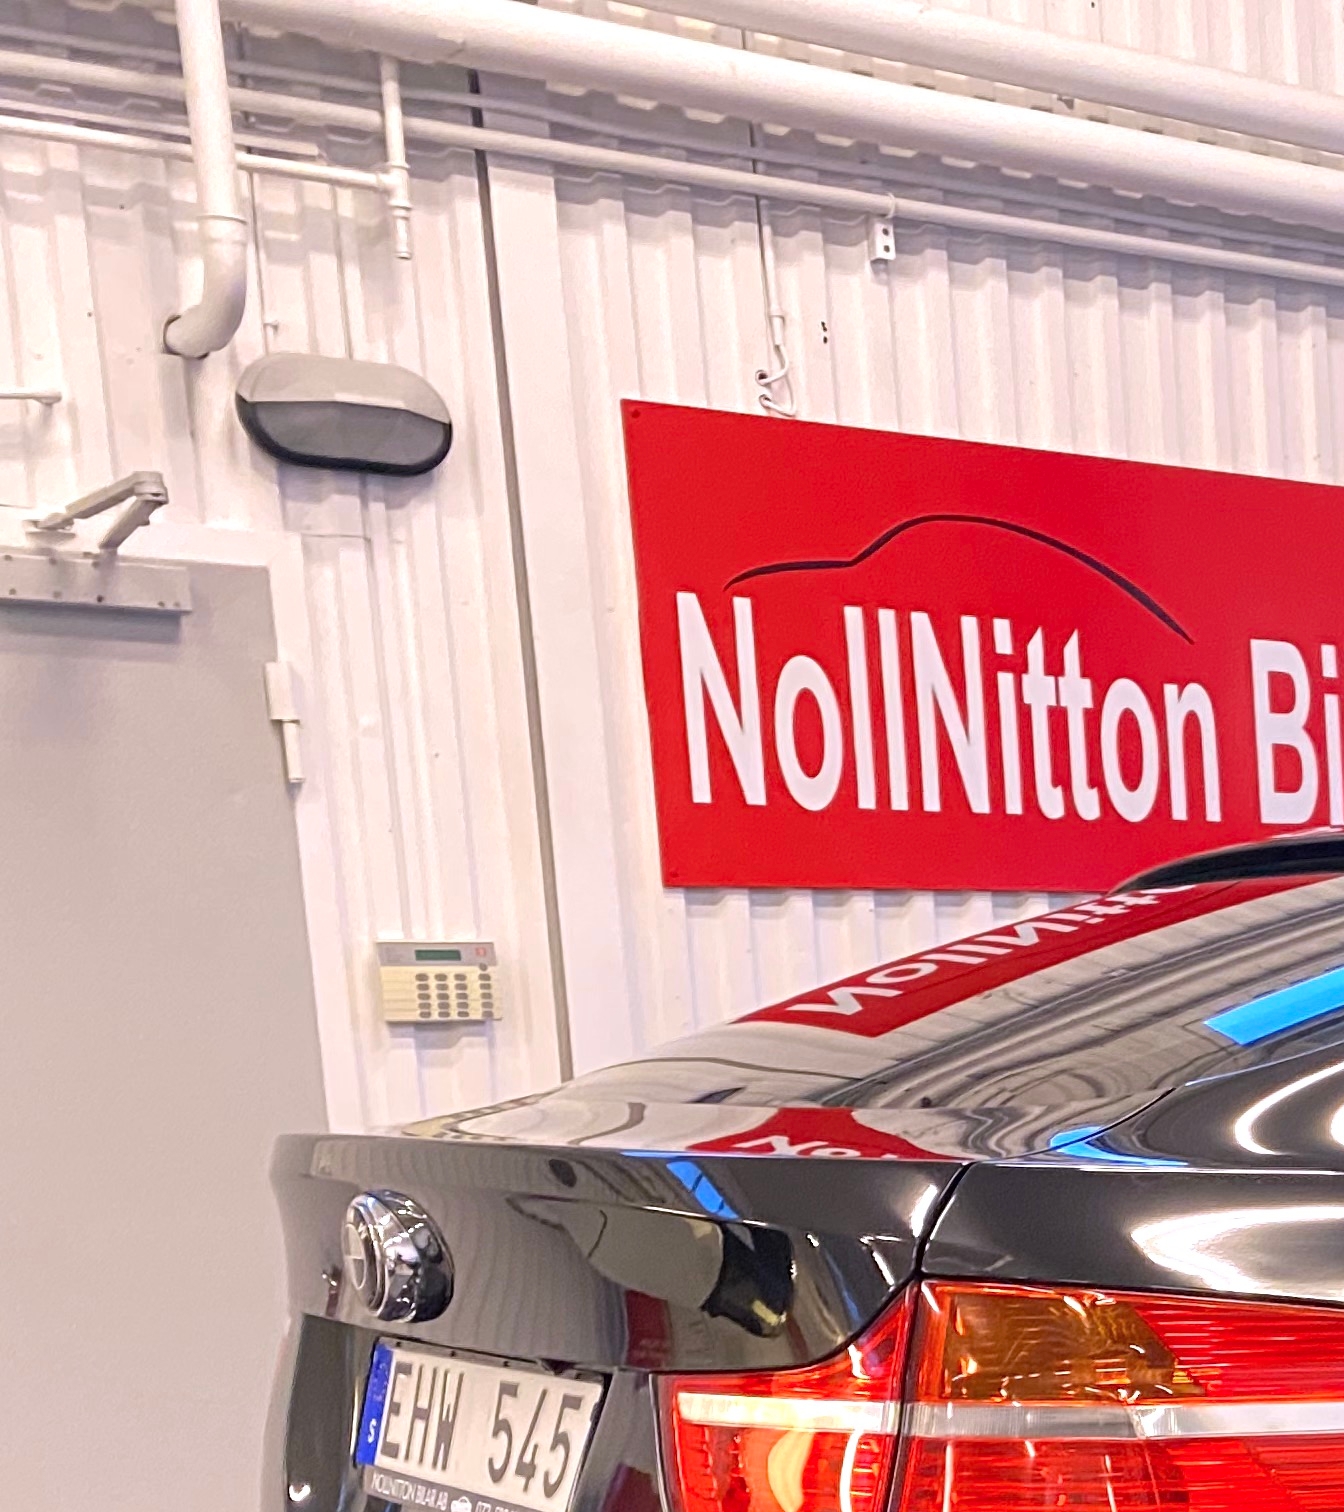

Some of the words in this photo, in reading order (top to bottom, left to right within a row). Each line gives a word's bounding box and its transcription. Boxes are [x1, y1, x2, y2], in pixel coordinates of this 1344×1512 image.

[676, 591, 1222, 824] NollNitton
[366, 1418, 377, 1444] S
[379, 1362, 465, 1473] EHW
[487, 1379, 583, 1499] 545
